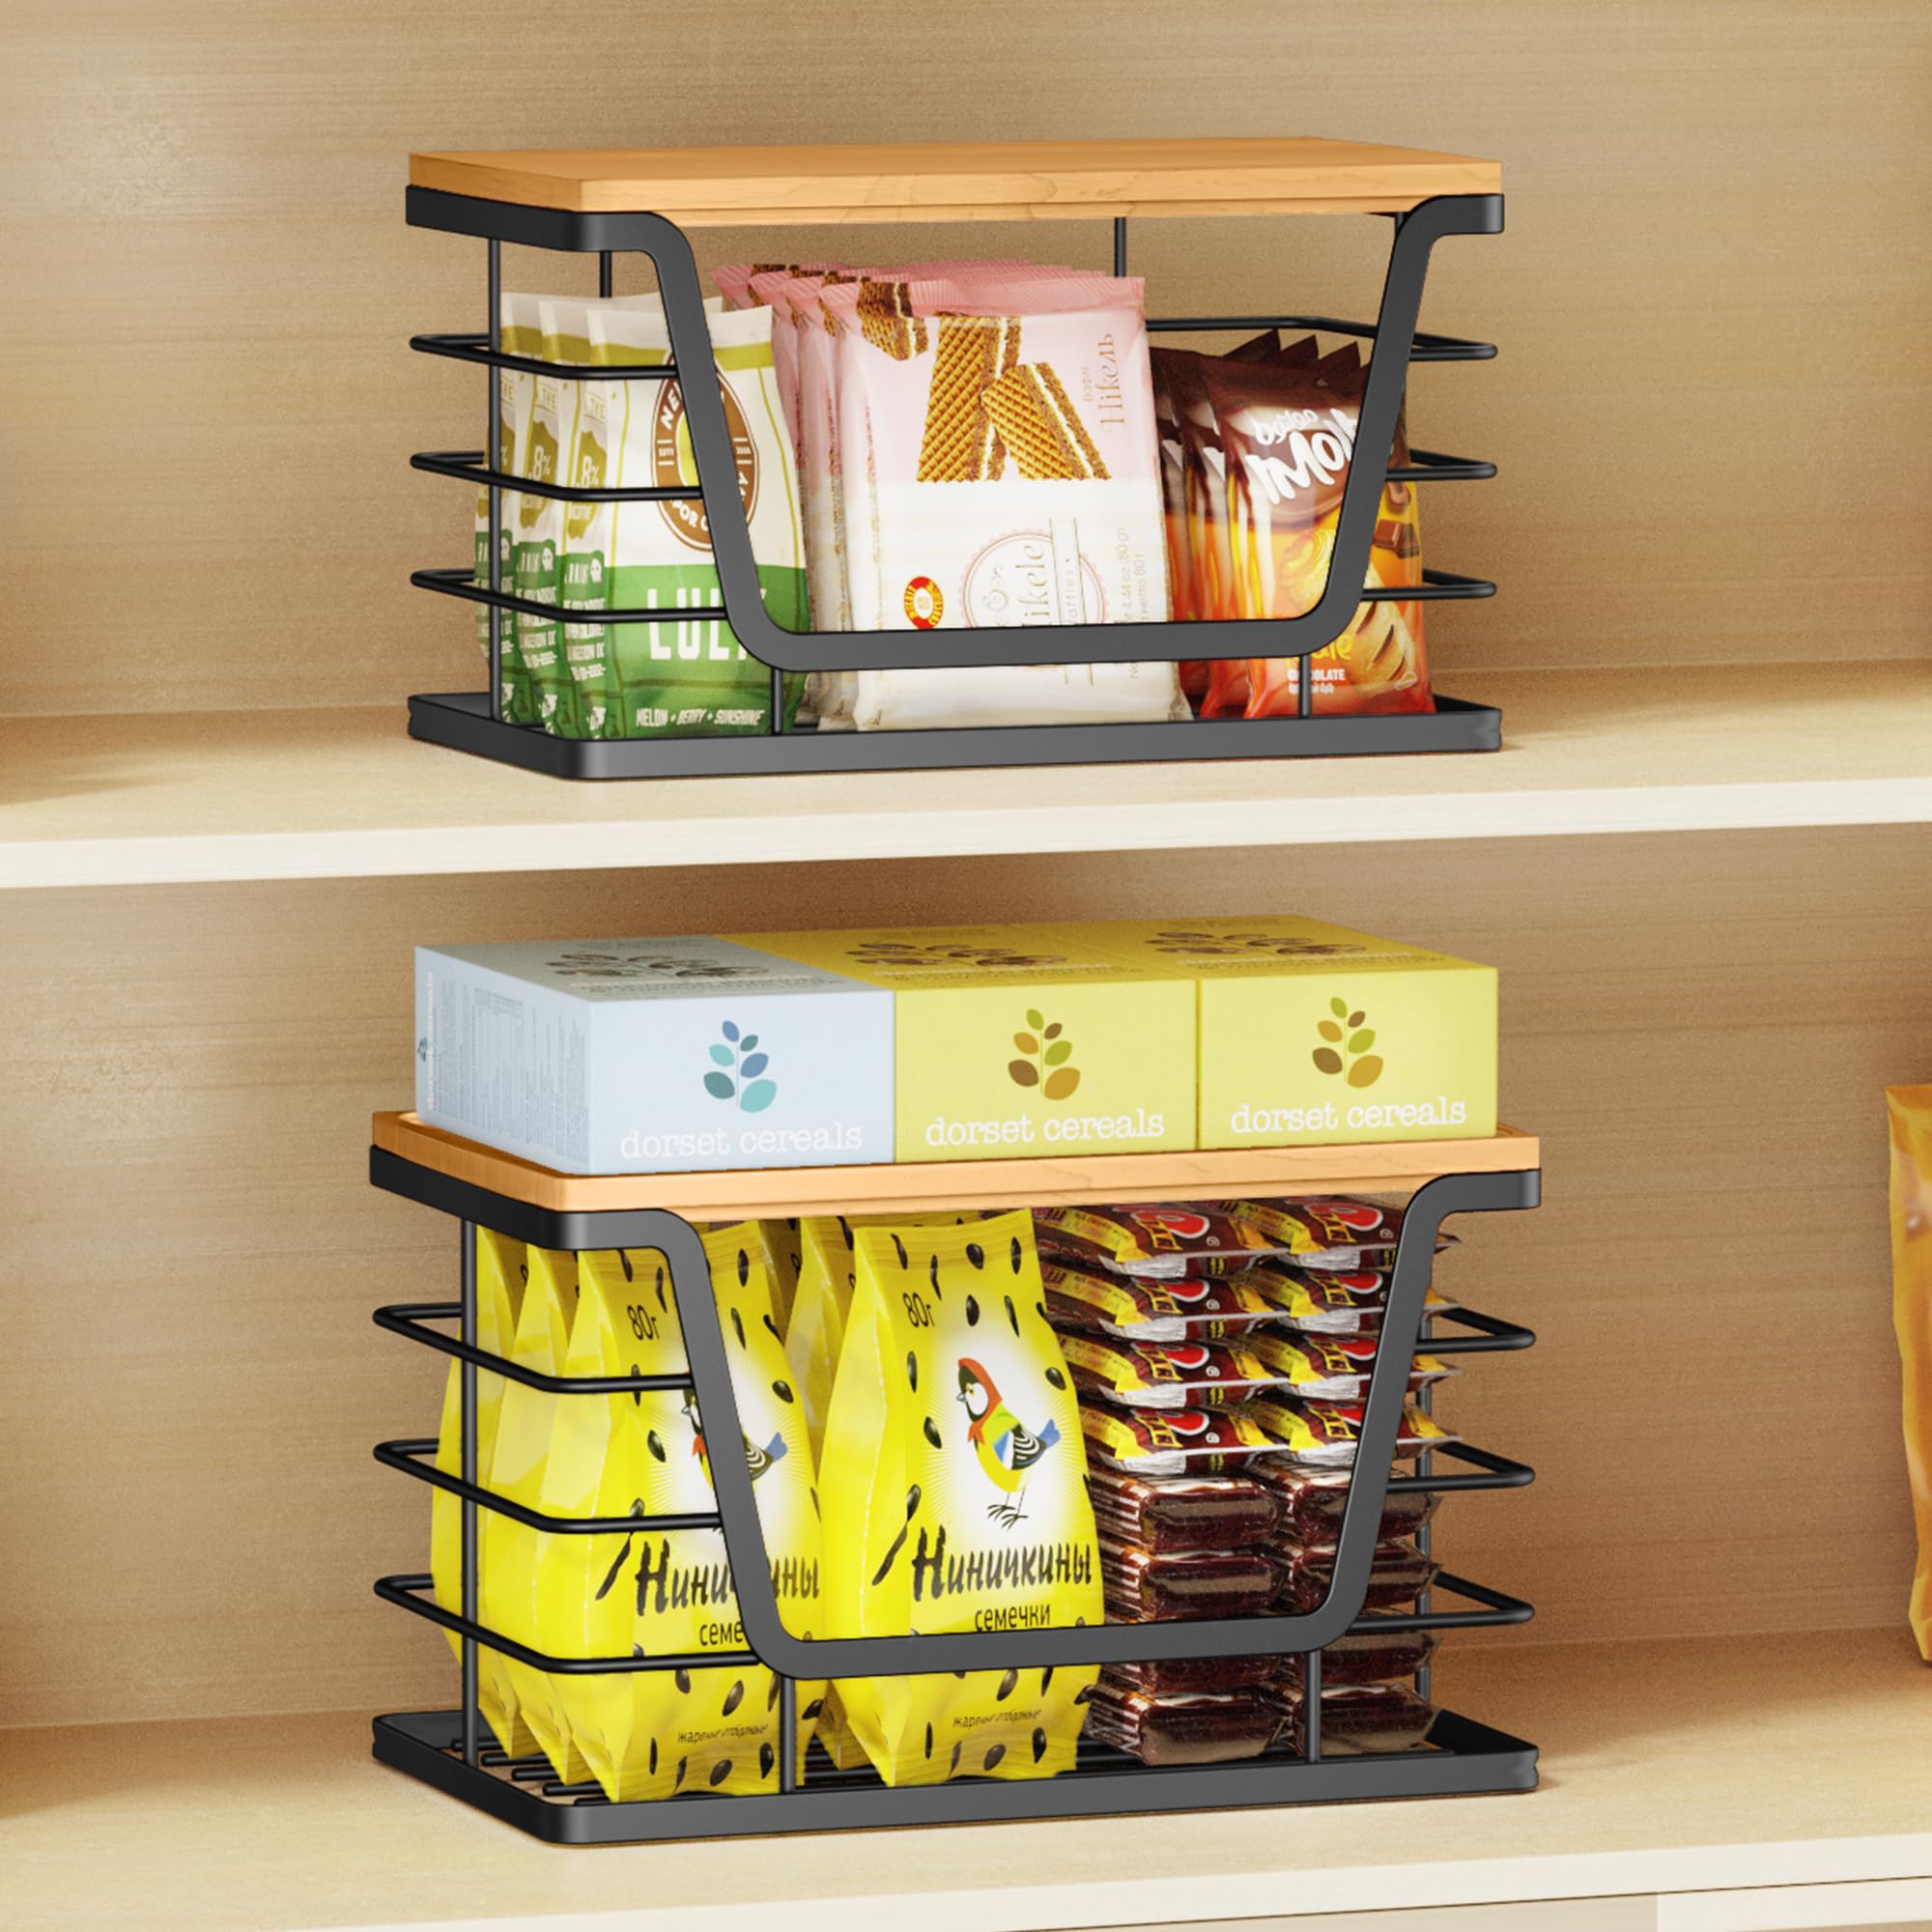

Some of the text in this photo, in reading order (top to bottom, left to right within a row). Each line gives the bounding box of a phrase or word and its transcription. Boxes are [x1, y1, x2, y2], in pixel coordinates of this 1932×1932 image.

[647, 587, 767, 661] LUL
[924, 1109, 1165, 1148] dorset cereals
[1230, 1095, 1466, 1134] dorset cereals
[620, 1122, 863, 1160] dorset cereals
[912, 1524, 1093, 1603] Ниничкины
[698, 1621, 743, 1647] семе
[975, 1604, 1051, 1633] семечки
